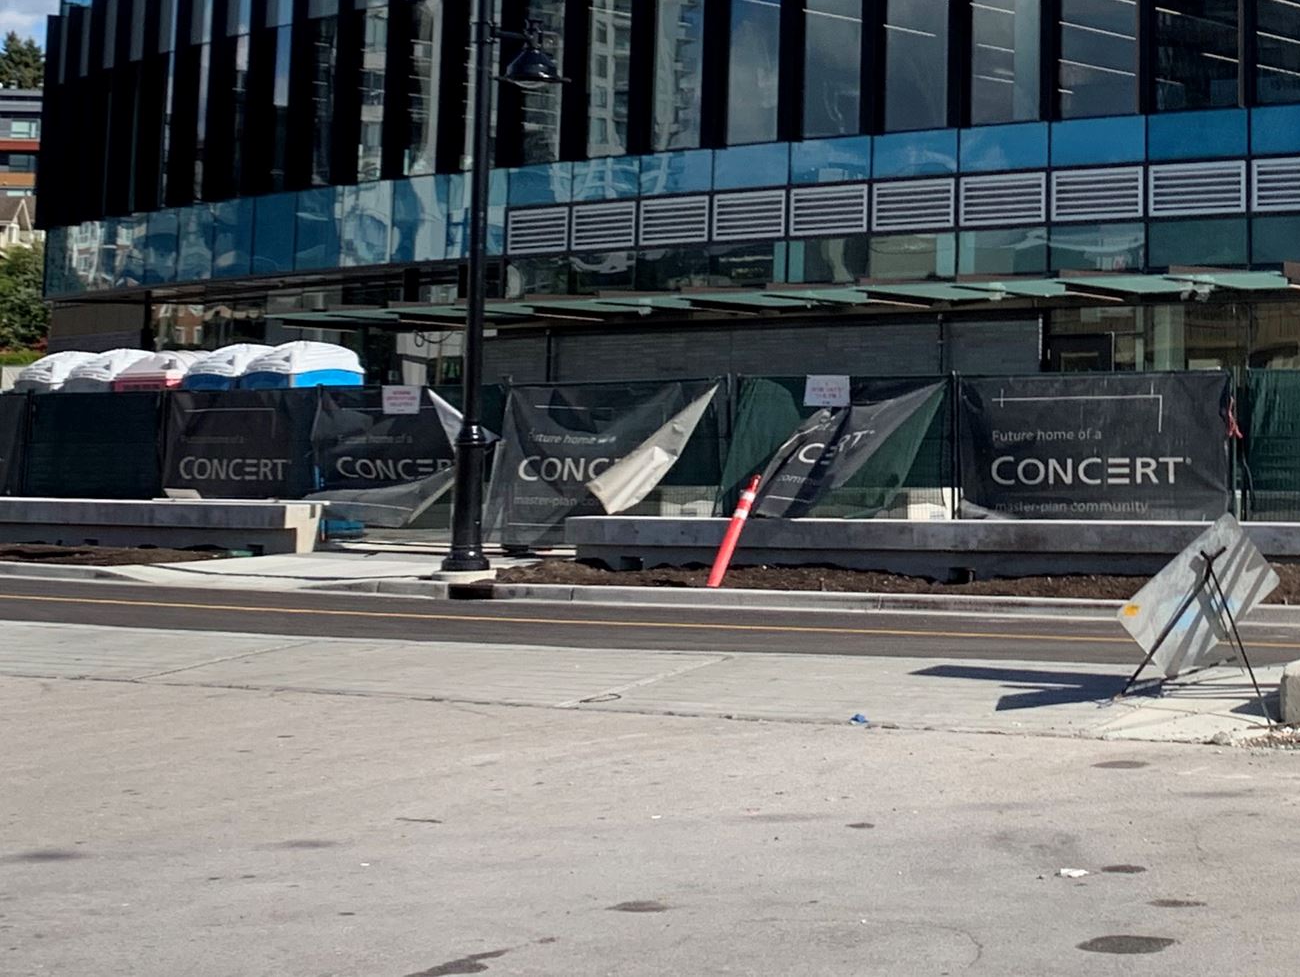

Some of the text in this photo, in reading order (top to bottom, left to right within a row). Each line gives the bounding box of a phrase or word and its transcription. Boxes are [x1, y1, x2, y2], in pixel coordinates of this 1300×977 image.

[992, 428, 1102, 442] Future home of a
[179, 456, 286, 480] CONCERT
[991, 455, 1184, 485] CONCERT
[994, 501, 1150, 513] master-plan community
